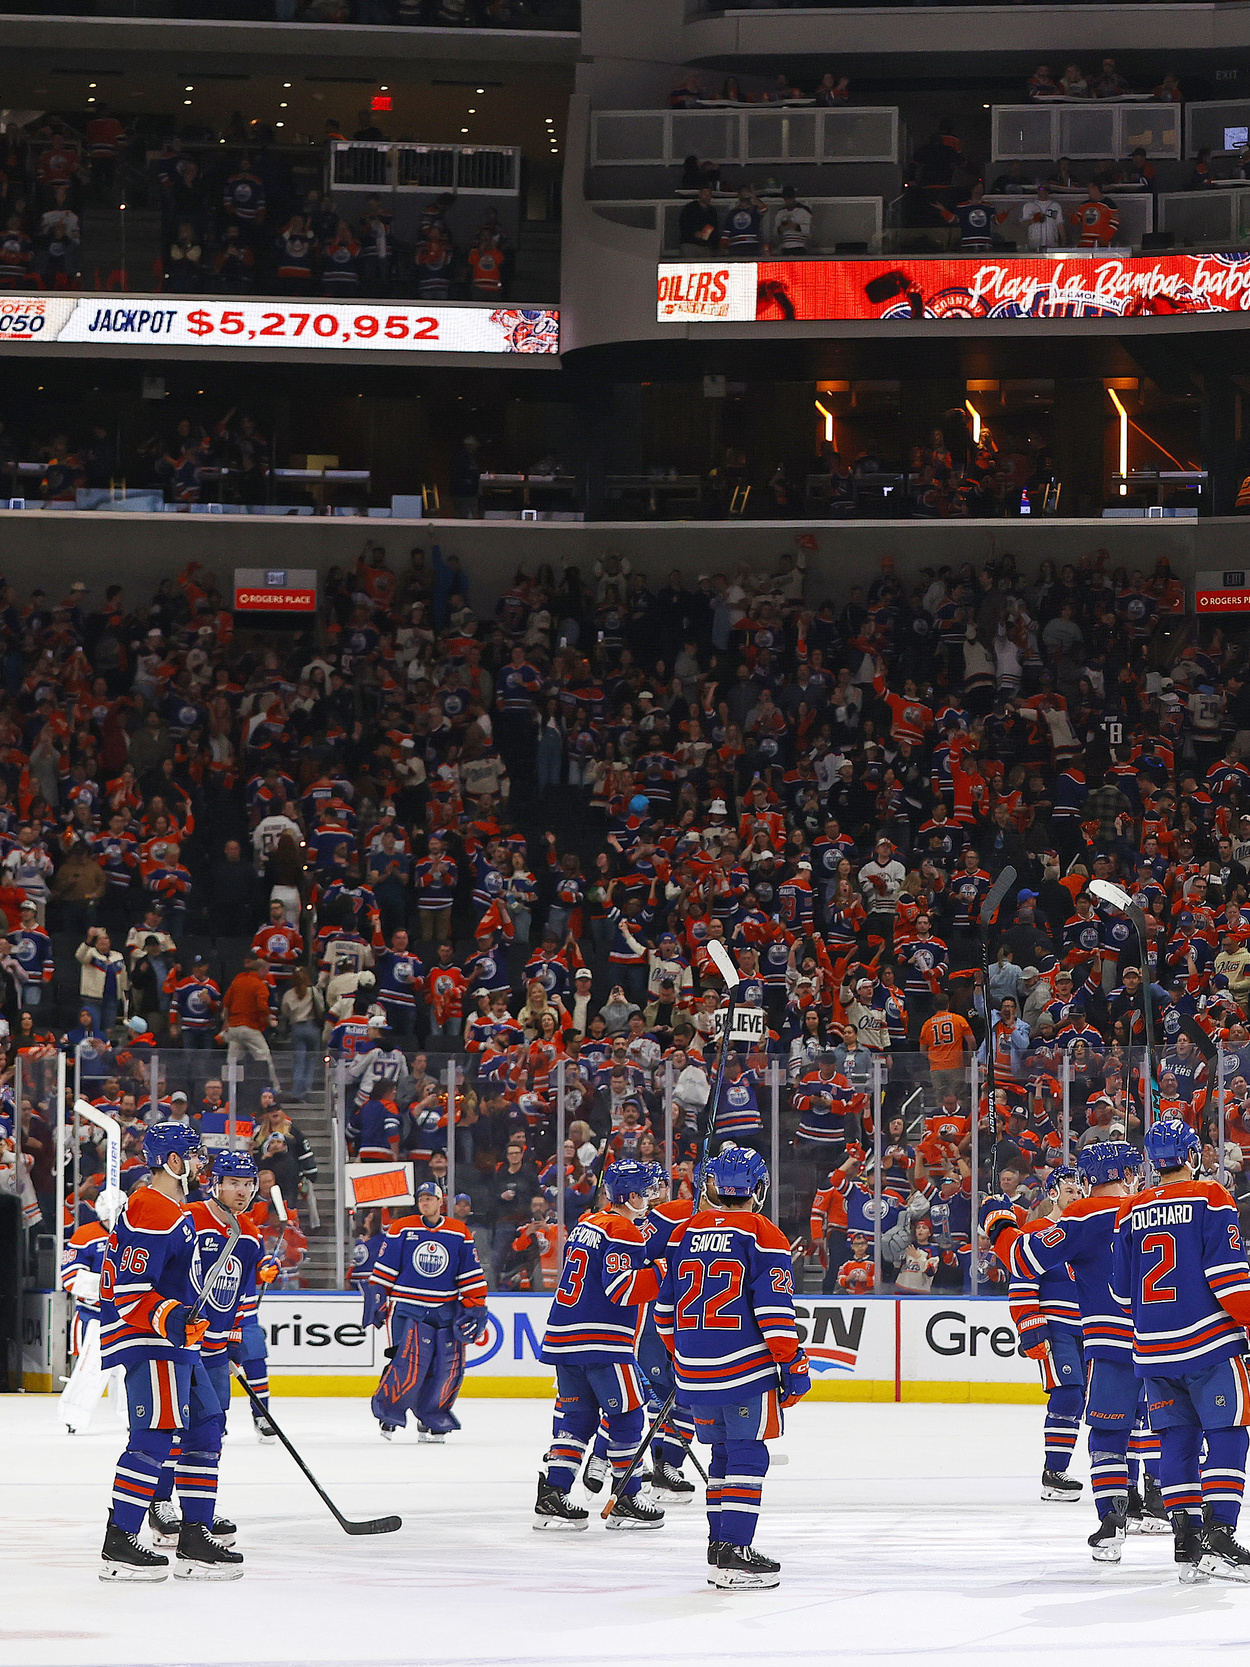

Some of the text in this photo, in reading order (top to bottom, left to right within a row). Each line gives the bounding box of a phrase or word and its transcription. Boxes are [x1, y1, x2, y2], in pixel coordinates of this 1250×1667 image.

[658, 270, 729, 302] OILERS
[969, 265, 1038, 312] Play
[1046, 262, 1087, 304] La
[1094, 260, 1183, 298] Bamba
[89, 308, 440, 343] JACKPOT $5,270,952
[250, 594, 311, 604] ROGERS PLACE
[1209, 596, 1242, 605] ROGERS
[933, 1022, 955, 1047] 19
[109, 1139, 119, 1188] BAUER
[1131, 1204, 1193, 1231] OUCHARD
[690, 1232, 733, 1255] SAVOIE
[1226, 1224, 1241, 1251] 2
[119, 1245, 151, 1276] 96
[605, 1251, 634, 1276] 93
[1142, 1230, 1178, 1305] 2
[556, 1246, 590, 1309] 3
[768, 1267, 794, 1296] 22
[675, 1257, 748, 1332] 22
[925, 1310, 1027, 1358] Gre
[1019, 1315, 1048, 1331] WARRI
[1088, 1410, 1126, 1420] BAUER
[1148, 1398, 1175, 1412] CCM
